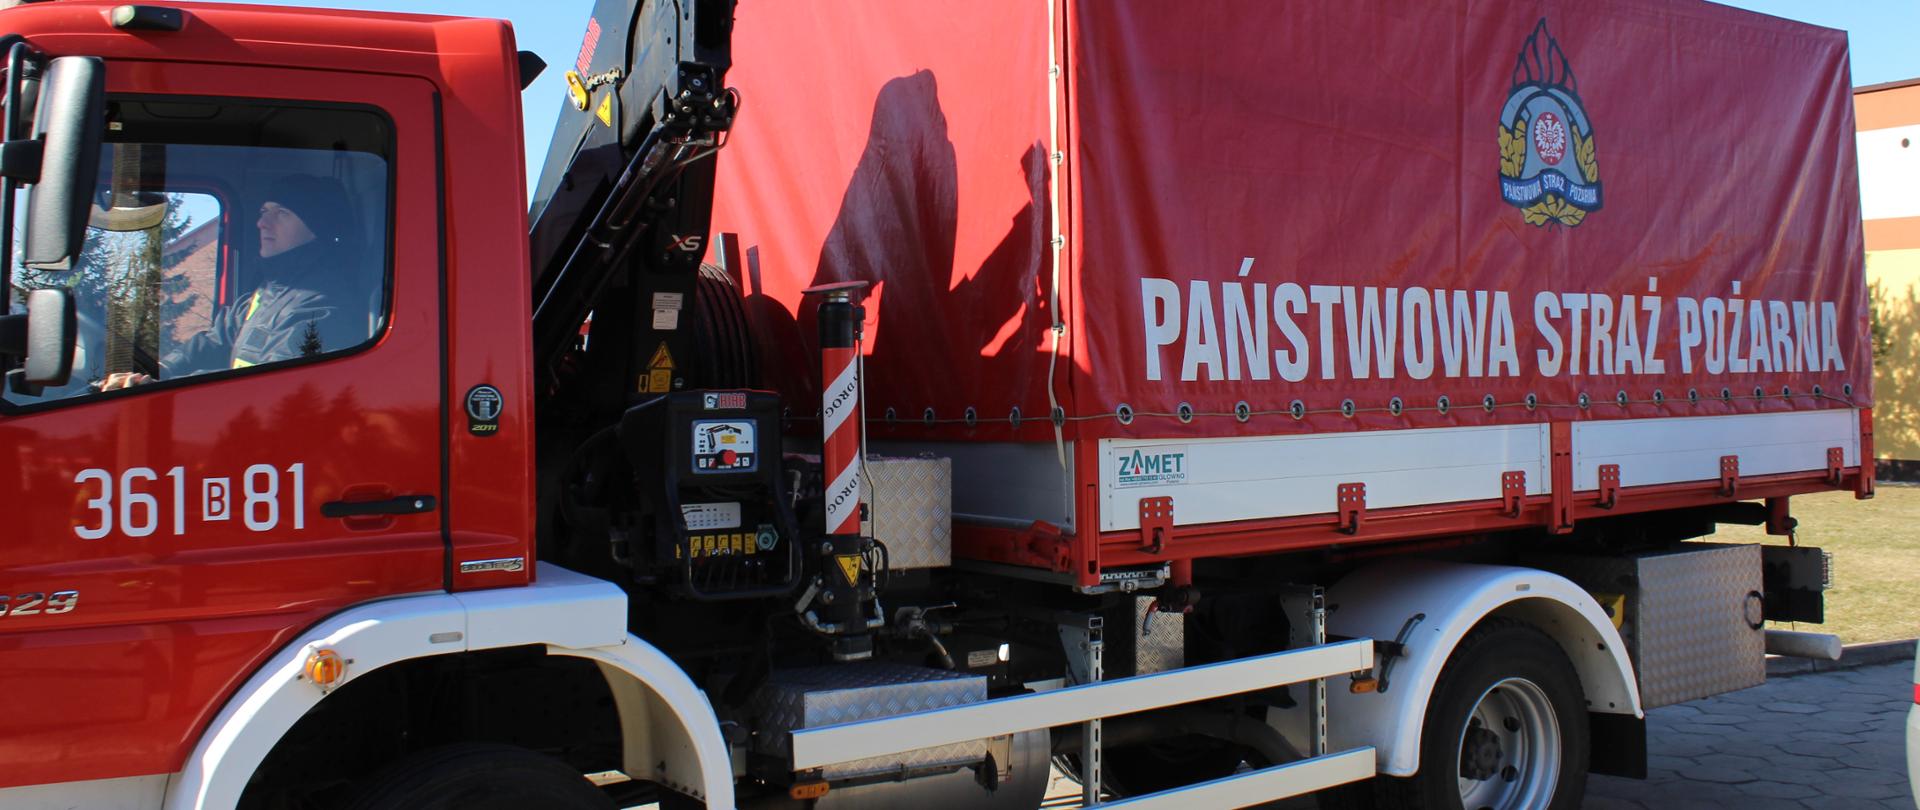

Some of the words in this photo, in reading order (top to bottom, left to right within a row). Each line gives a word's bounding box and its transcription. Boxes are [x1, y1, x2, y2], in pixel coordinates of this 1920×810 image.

[666, 234, 702, 251] XS
[1141, 257, 1521, 382] PAŃSTWOWA
[1534, 276, 1665, 377] STRAŻ
[1678, 280, 1846, 374] POŻARNA
[719, 393, 747, 409] HIAB
[1119, 449, 1184, 475] ZAMET
[74, 466, 185, 539] 361
[206, 480, 228, 518] B
[243, 463, 304, 532] 81
[827, 472, 860, 515] DROG
